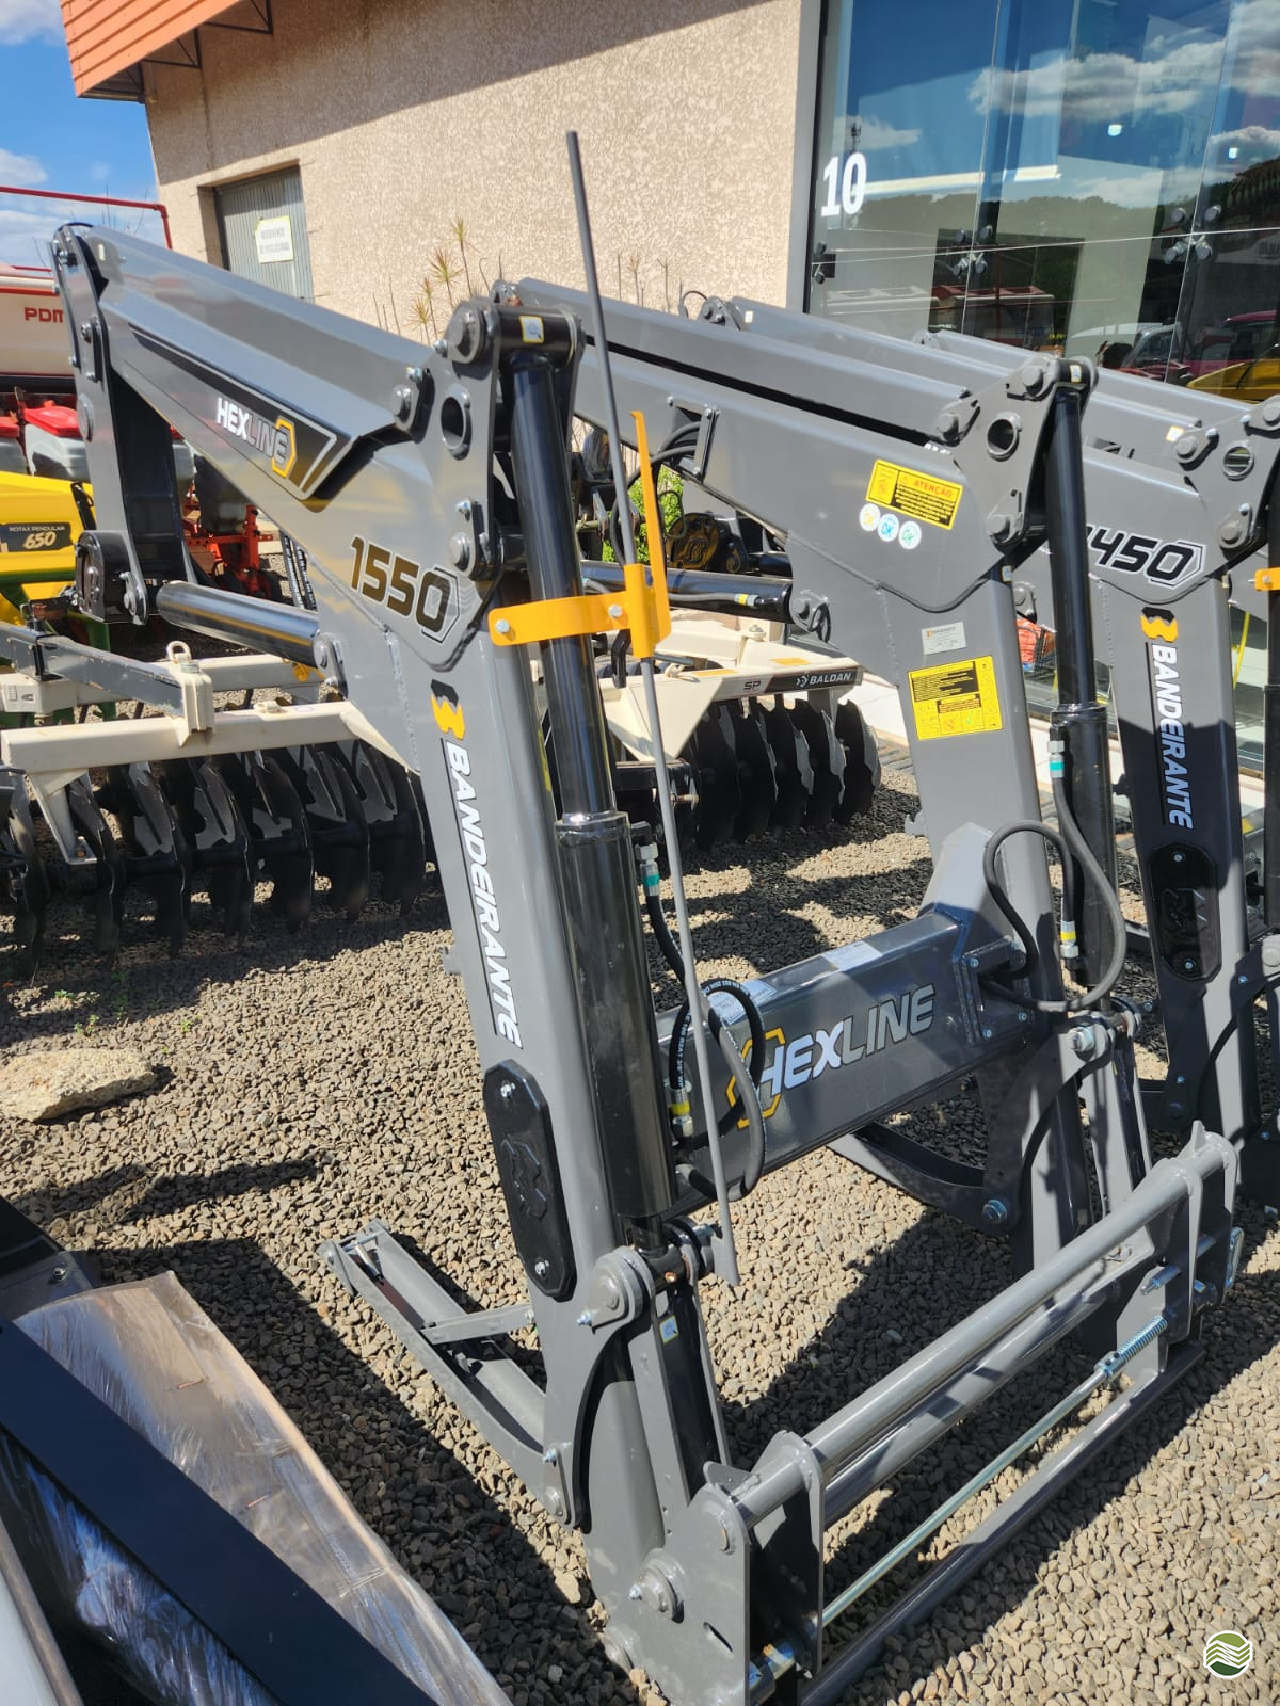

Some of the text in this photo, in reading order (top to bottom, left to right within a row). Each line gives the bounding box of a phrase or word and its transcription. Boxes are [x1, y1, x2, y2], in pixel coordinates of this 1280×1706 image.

[821, 151, 867, 216] 10
[216, 397, 289, 465] HEXLINE
[24, 531, 56, 550] 650
[1086, 525, 1195, 582] 450
[350, 536, 452, 634] 1550
[809, 672, 852, 685] BALDAN
[1151, 643, 1194, 830] BANDEIRANTE
[446, 740, 524, 1050] BANDEIRANTE
[760, 983, 936, 1098] HEXLINE
